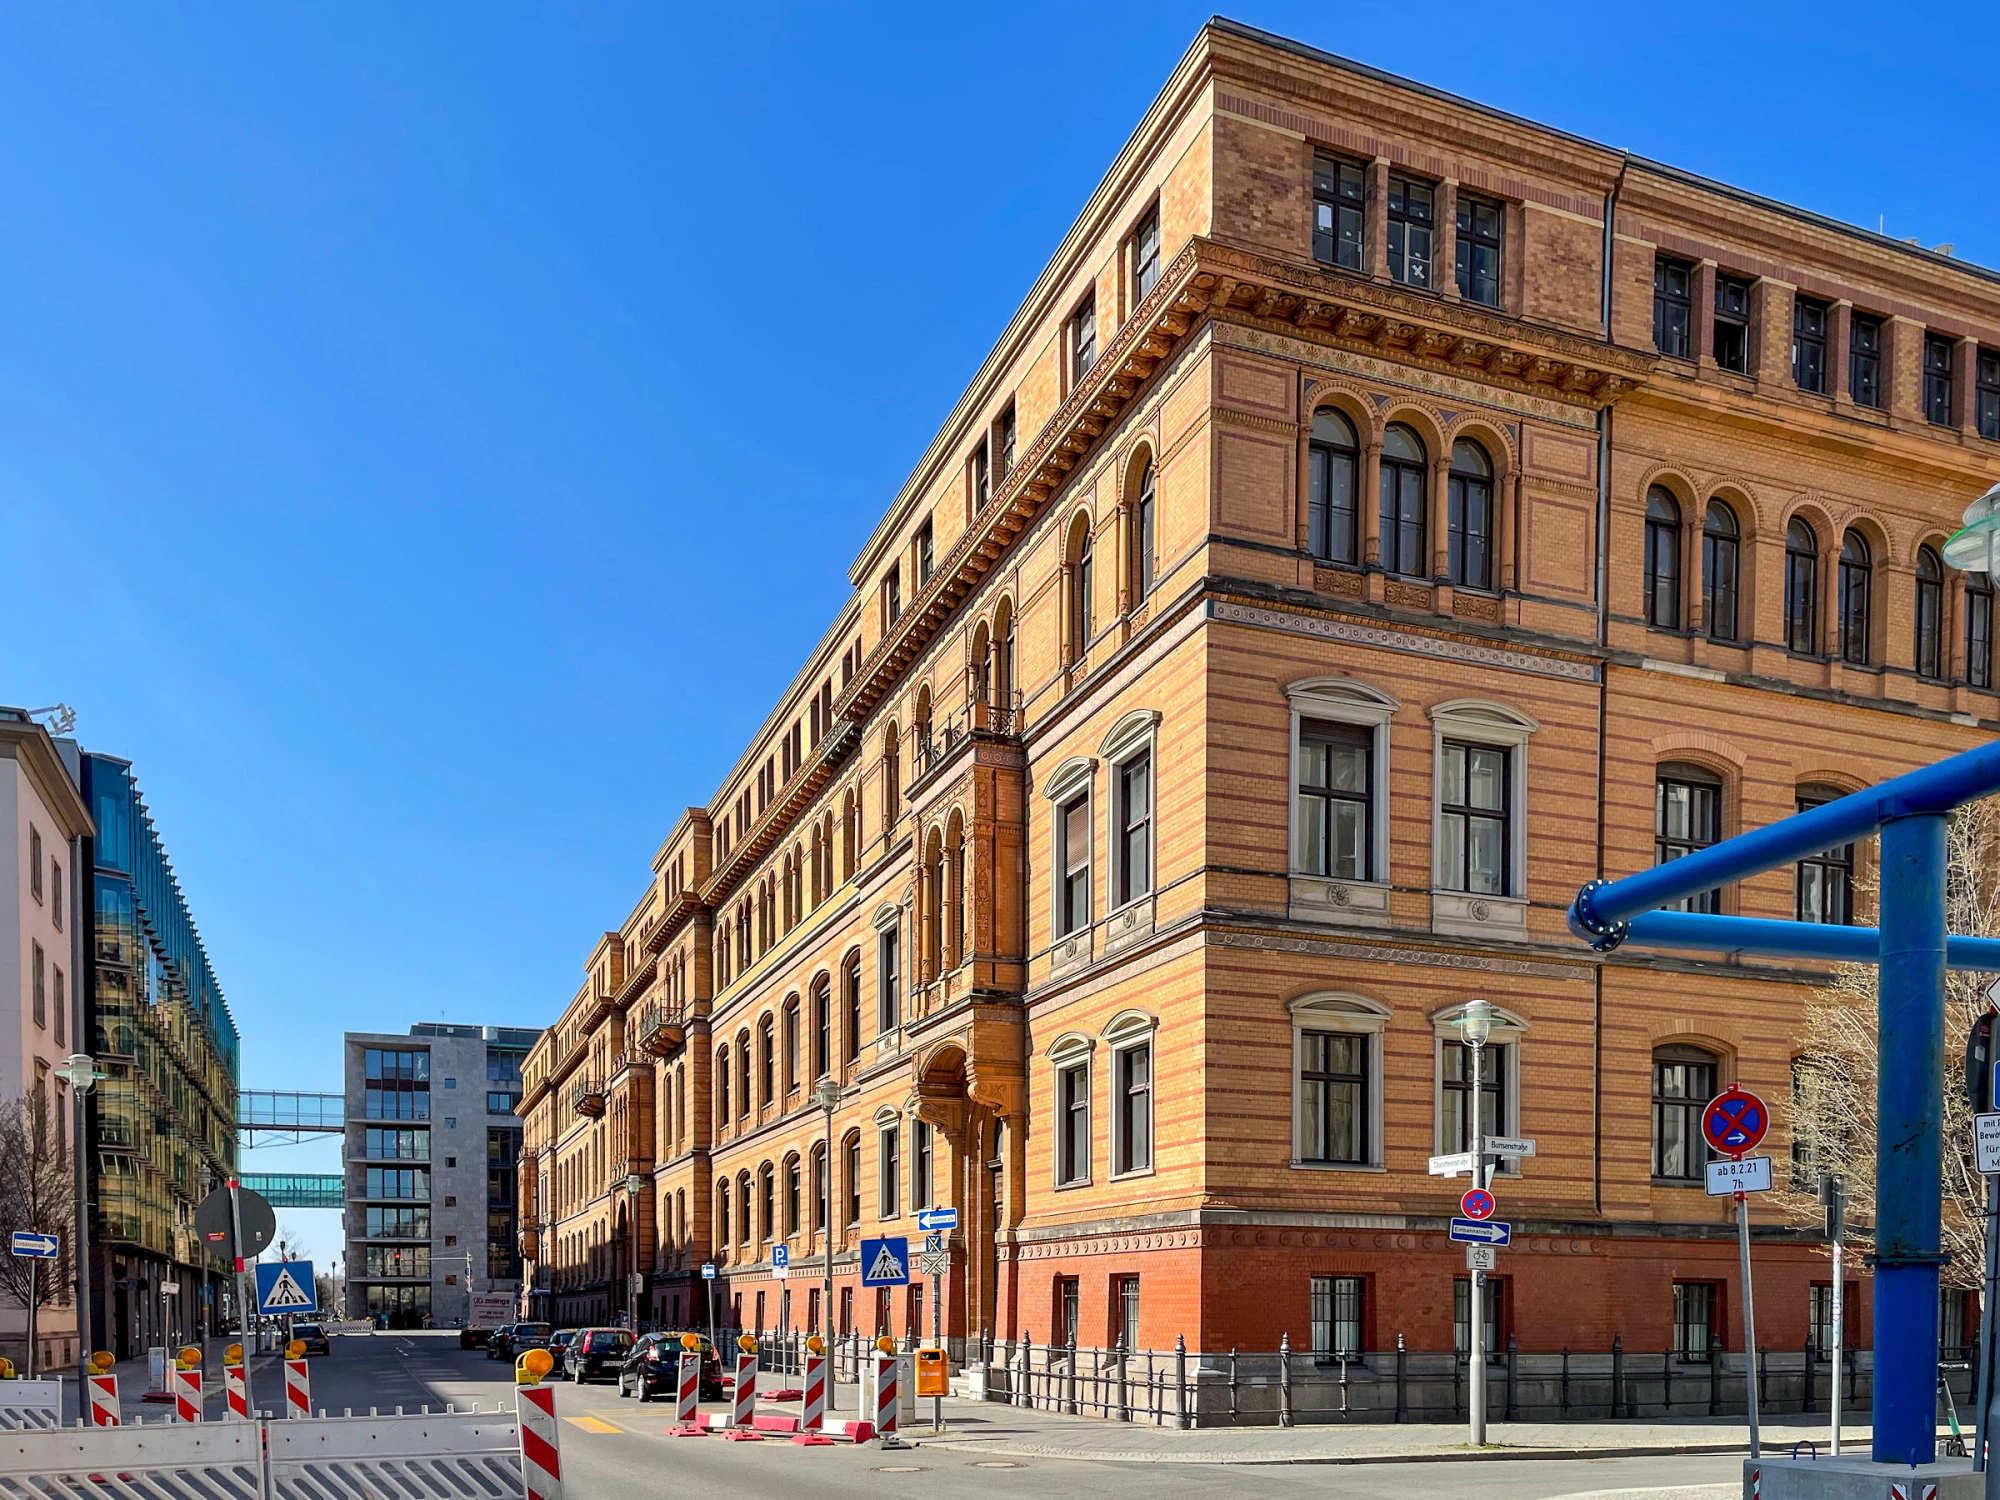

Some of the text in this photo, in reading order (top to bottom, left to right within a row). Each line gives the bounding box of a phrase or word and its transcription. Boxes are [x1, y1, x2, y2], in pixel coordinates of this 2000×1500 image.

[1983, 1120, 1996, 1128] mit
[1980, 1131, 2000, 1140] Bewo
[1491, 1140, 1528, 1152] Bunsenstraße
[1985, 1144, 1999, 1153] für
[1717, 1162, 1757, 1176] ab 8.2.21
[1732, 1178, 1744, 1189] 7h
[1454, 1227, 1493, 1236] Einbahnstraße
